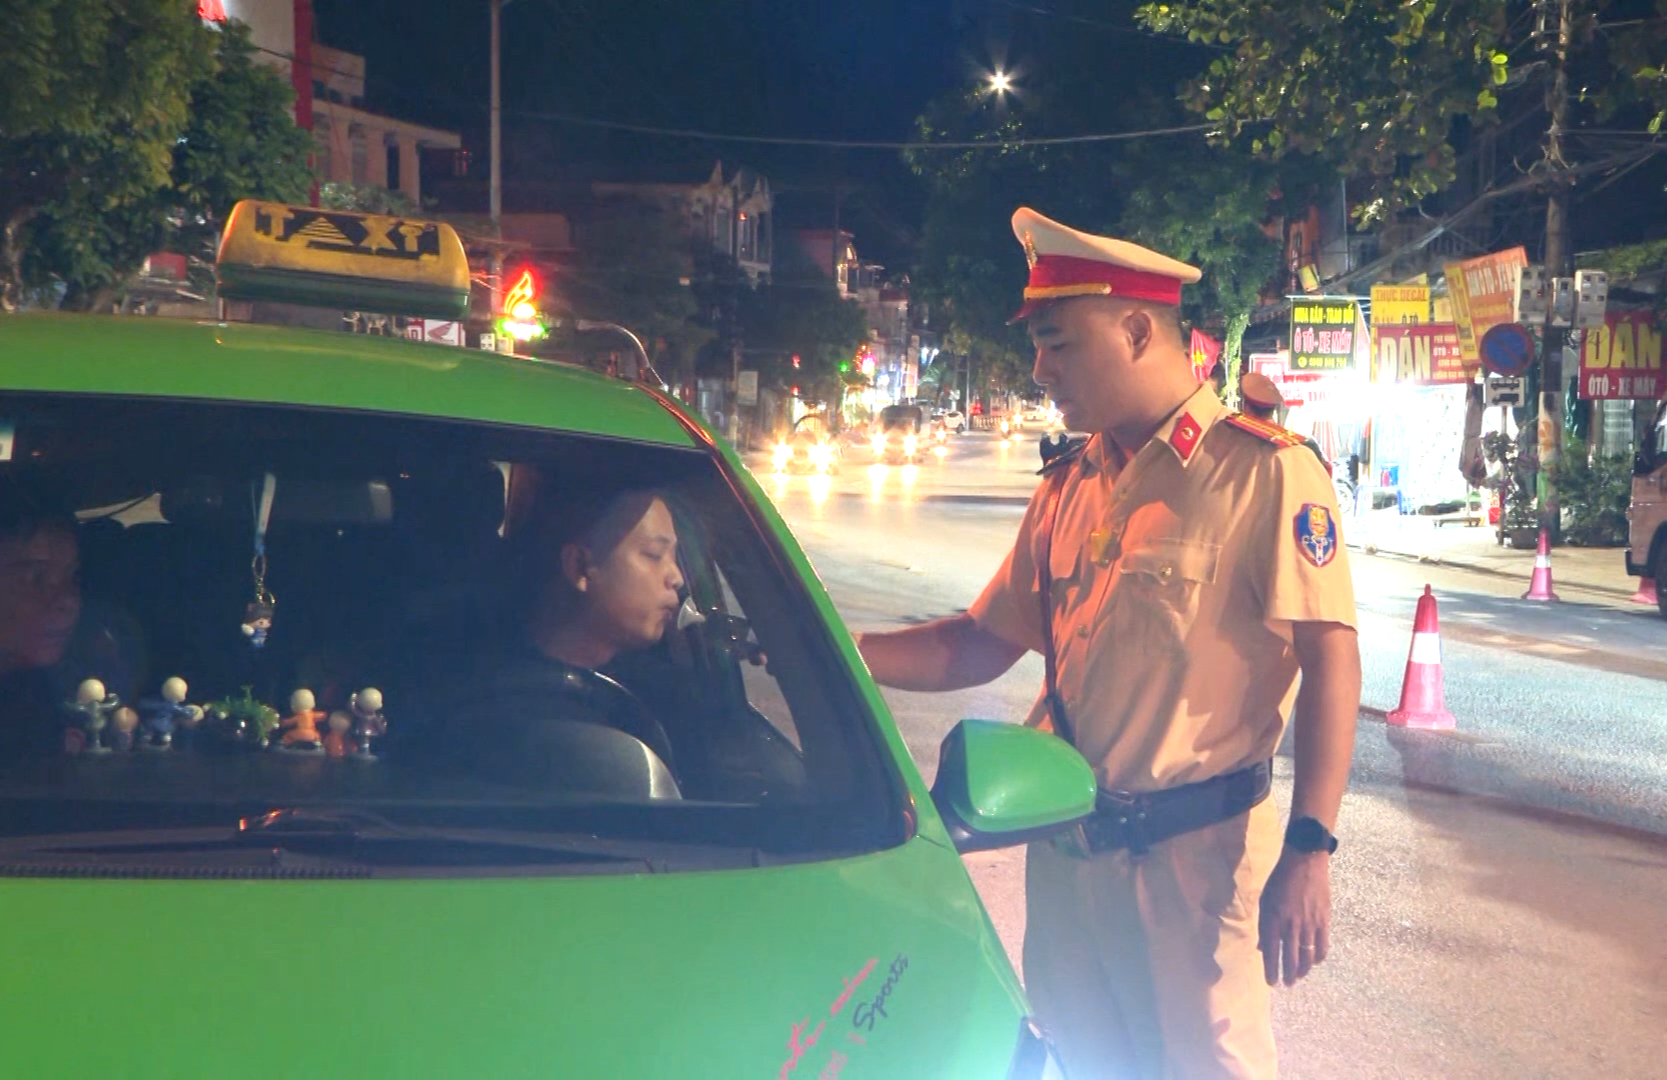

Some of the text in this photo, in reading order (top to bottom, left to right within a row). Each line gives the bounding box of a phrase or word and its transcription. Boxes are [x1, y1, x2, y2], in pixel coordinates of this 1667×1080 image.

[1380, 329, 1430, 382] DÁN
[1585, 315, 1661, 368] DÁN
[1588, 373, 1609, 396] ÔTÔ
[1618, 377, 1631, 396] XE
[852, 952, 909, 1032] Sports
